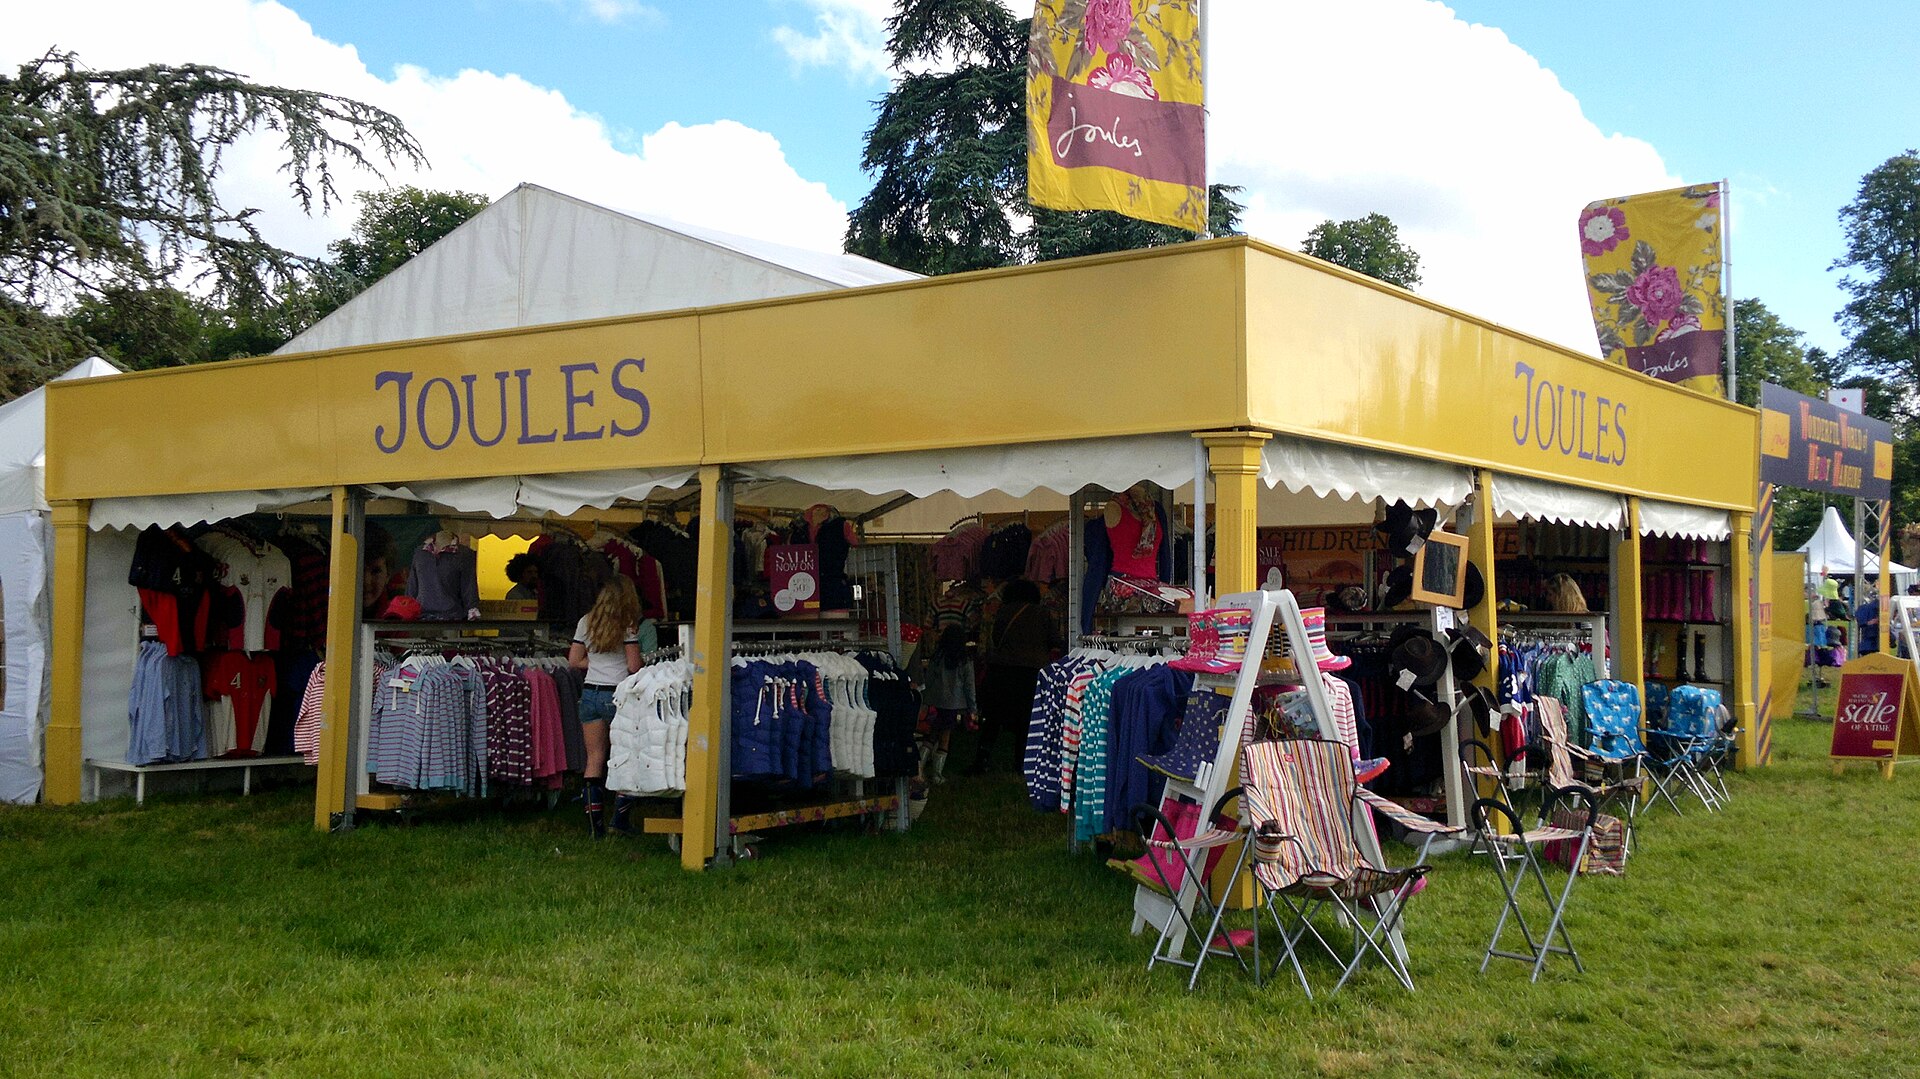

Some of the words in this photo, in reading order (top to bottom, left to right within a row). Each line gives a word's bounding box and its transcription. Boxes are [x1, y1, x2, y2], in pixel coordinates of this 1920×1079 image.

[1056, 92, 1142, 158] joules
[374, 357, 651, 454] JOULES
[1512, 360, 1627, 467] JOULES
[776, 551, 814, 562] SALE
[1259, 546, 1280, 557] SALE
[171, 566, 181, 585] 4
[776, 562, 798, 571] NOW
[800, 561, 814, 571] ON
[230, 672, 241, 689] 4
[1839, 691, 1896, 724] sale
